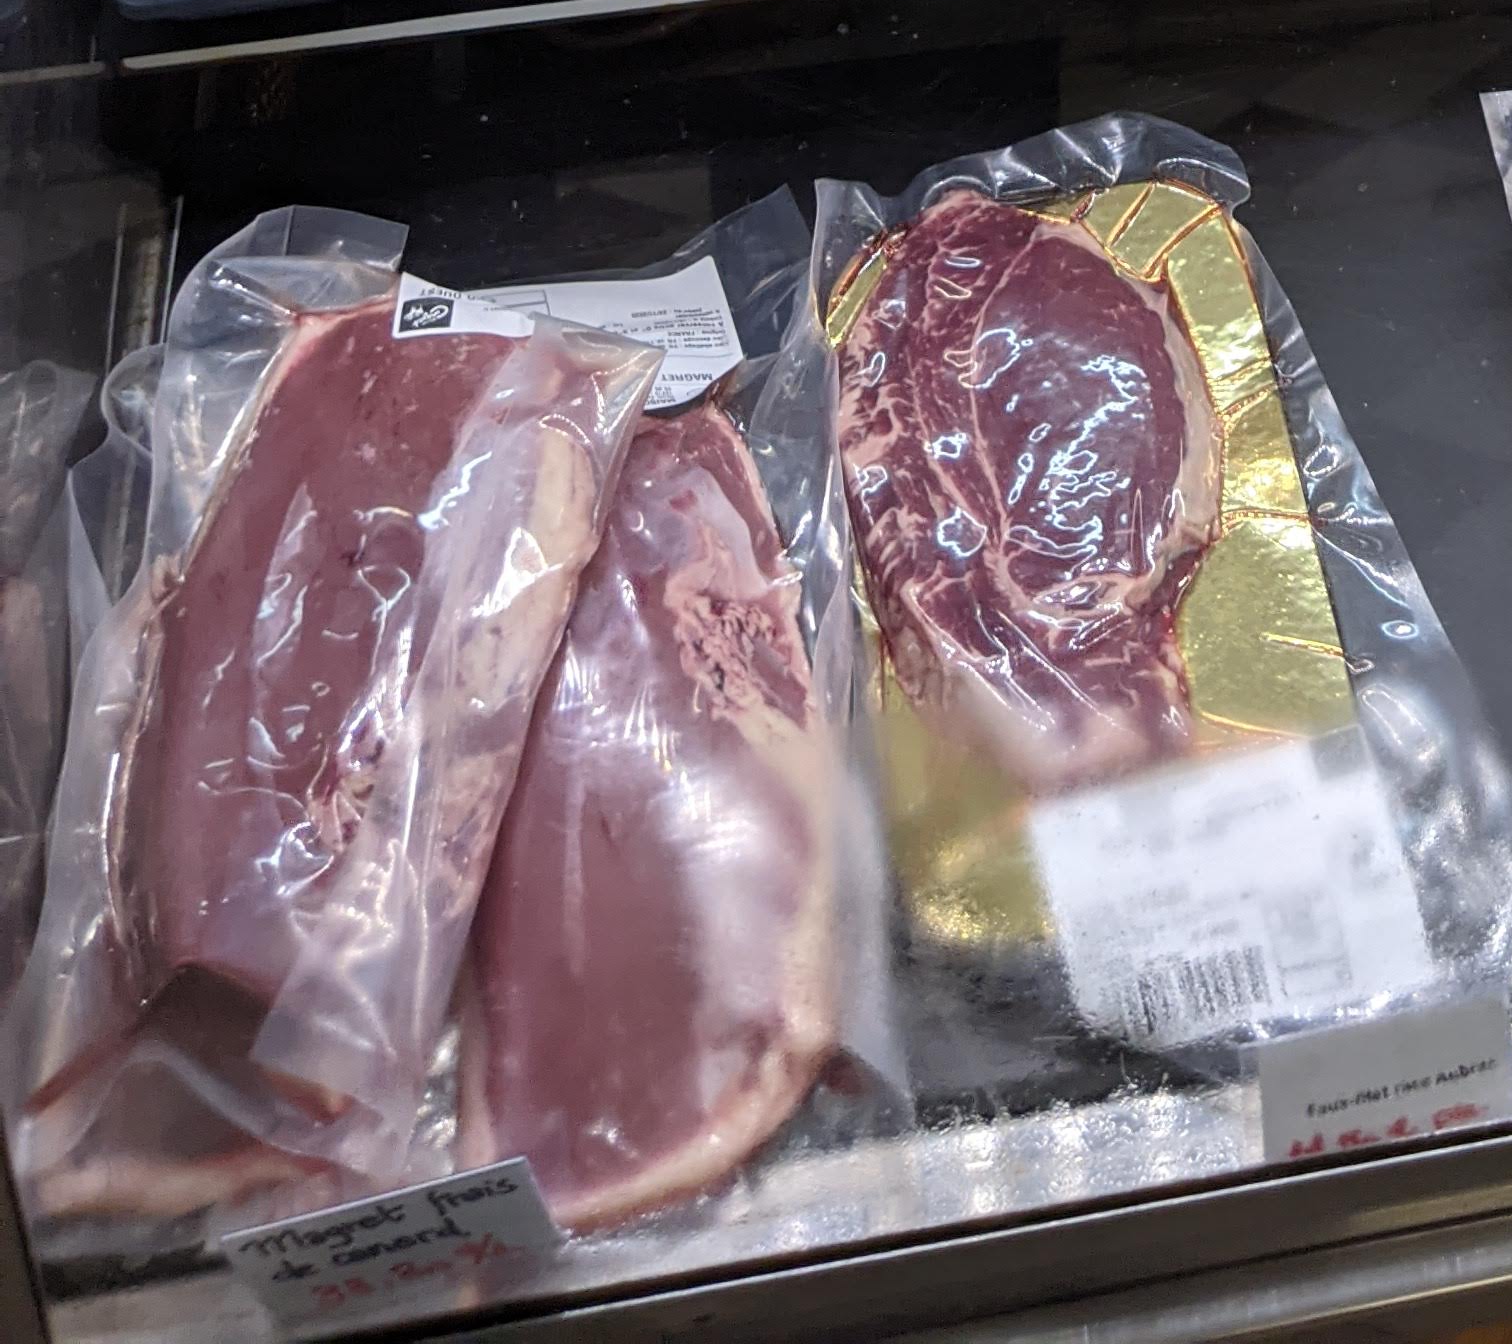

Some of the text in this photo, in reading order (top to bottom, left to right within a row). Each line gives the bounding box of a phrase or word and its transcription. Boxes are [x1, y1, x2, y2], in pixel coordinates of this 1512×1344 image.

[660, 371, 715, 384] MAGRET
[239, 1176, 520, 1258] Magret frais
[331, 1217, 473, 1266] canard
